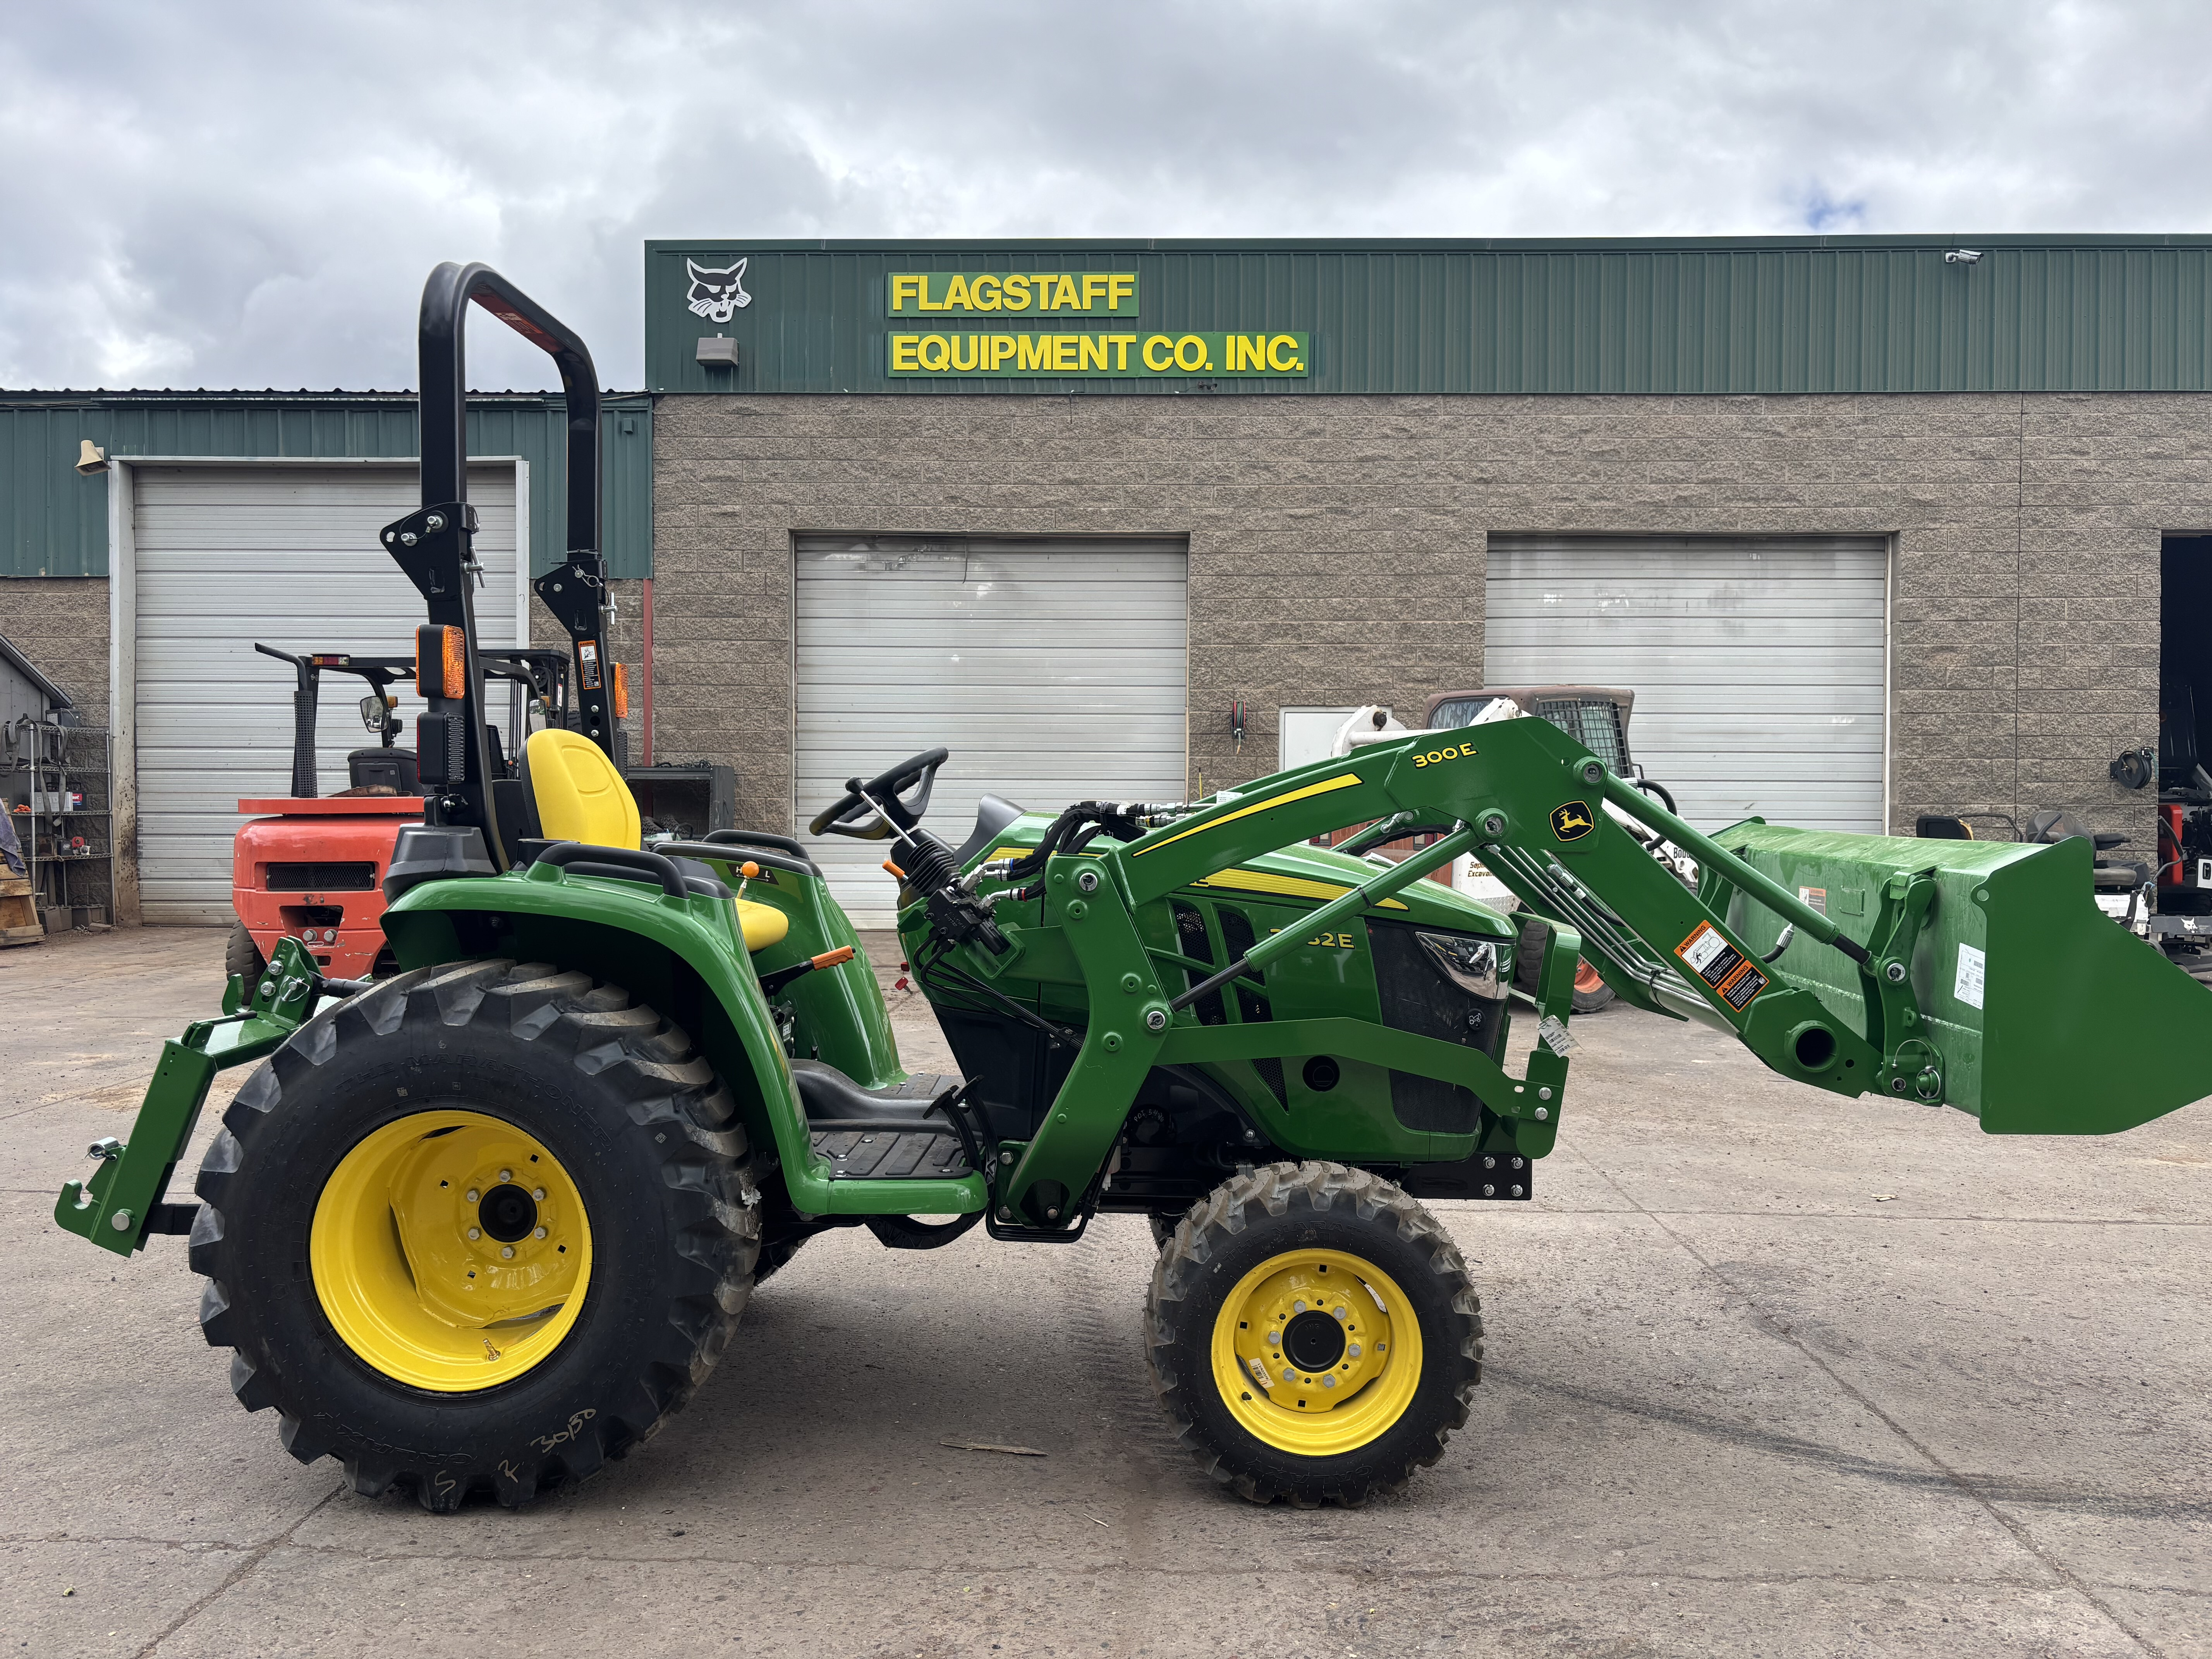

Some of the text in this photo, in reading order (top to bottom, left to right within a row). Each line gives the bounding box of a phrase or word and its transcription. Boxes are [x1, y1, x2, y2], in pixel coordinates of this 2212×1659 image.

[893, 274, 1134, 311] FLAGSTAFF
[893, 334, 1304, 371] EQUIPMENT CO. INC.
[1684, 925, 1706, 946] WARNING
[1726, 965, 1748, 987] WARNING
